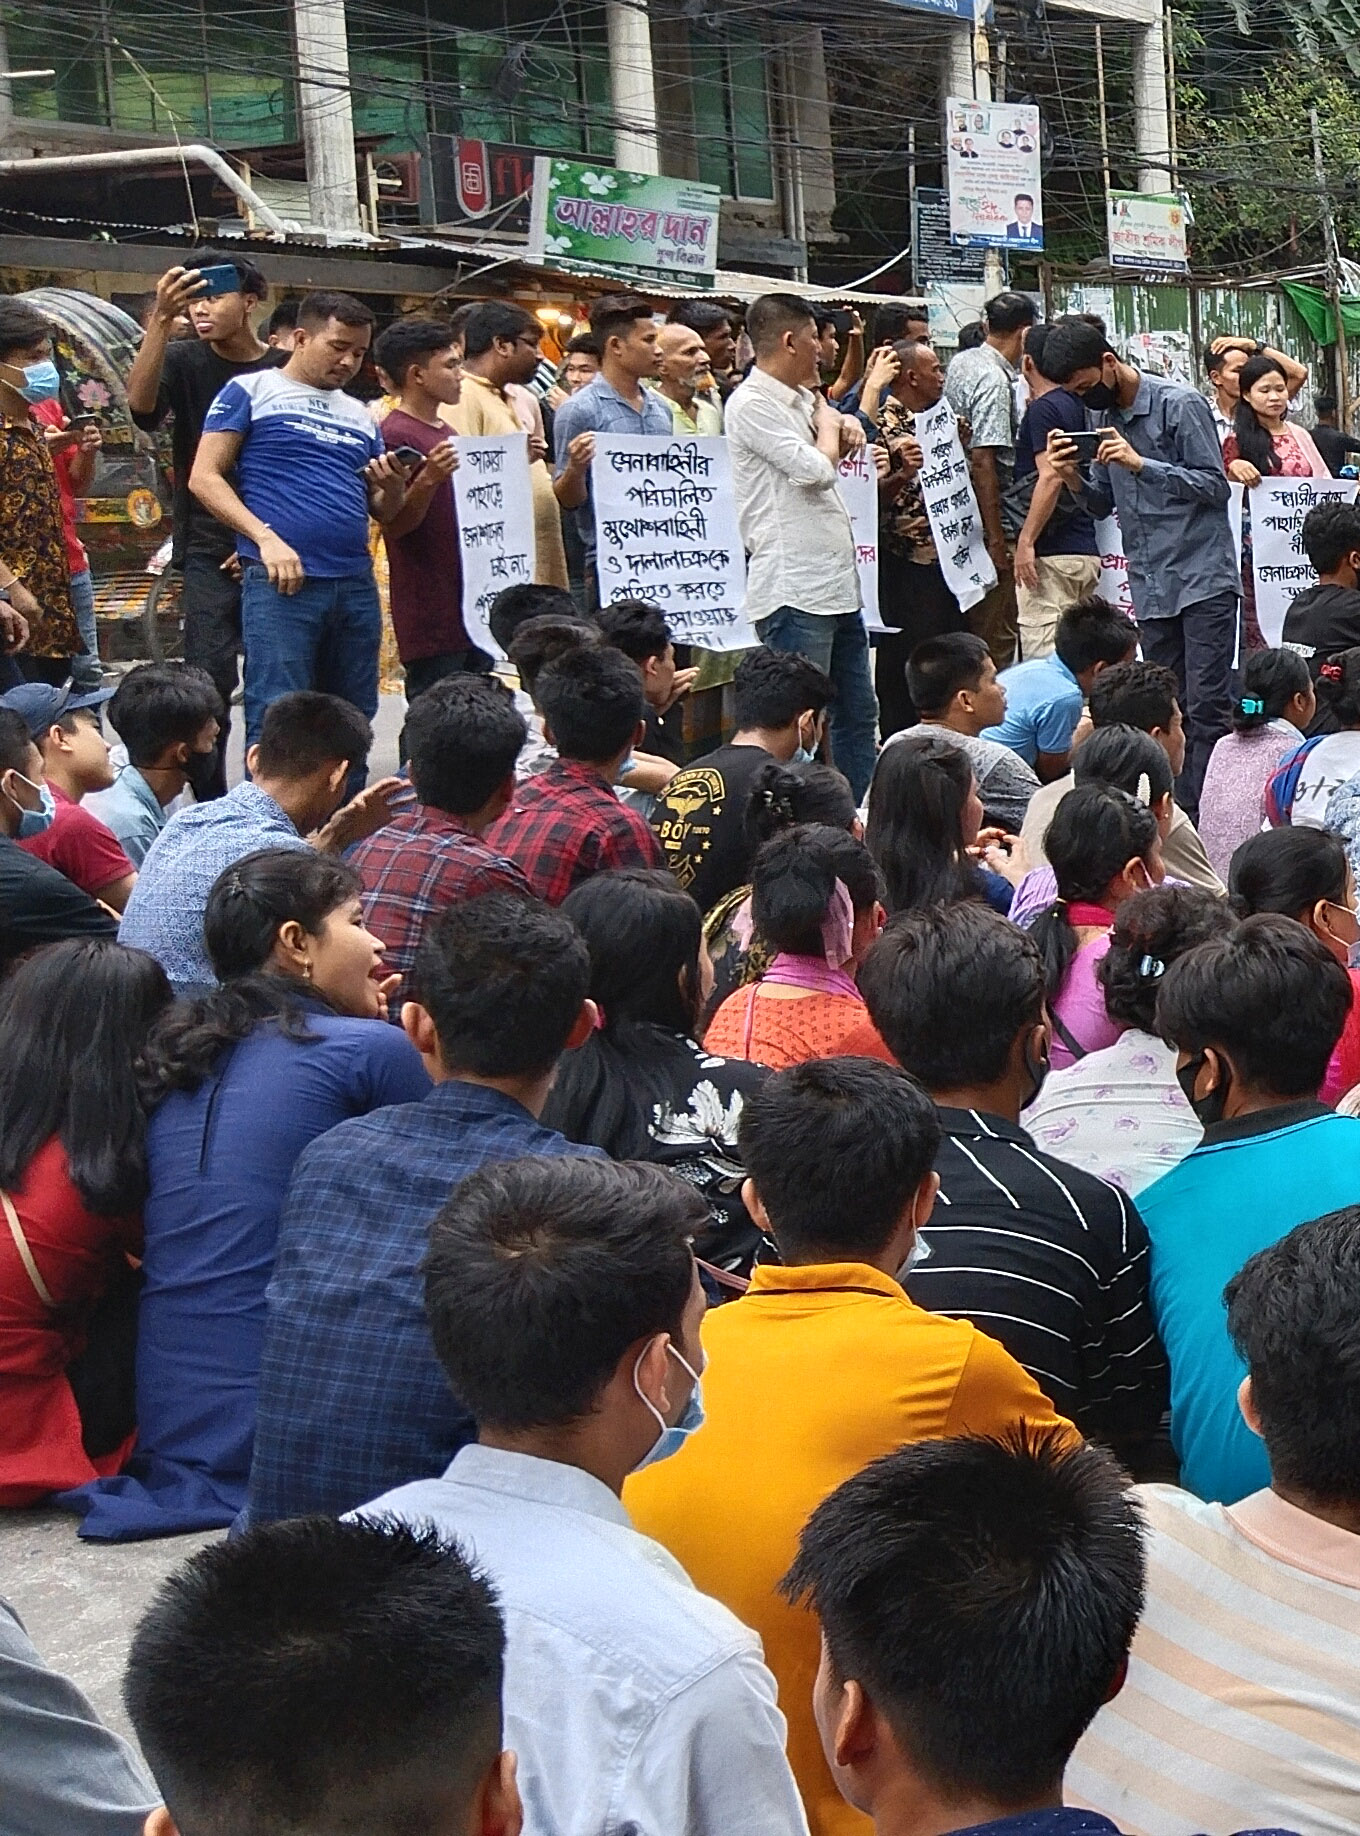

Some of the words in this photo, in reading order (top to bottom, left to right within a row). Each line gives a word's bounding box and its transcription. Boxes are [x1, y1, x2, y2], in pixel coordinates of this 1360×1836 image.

[555, 197, 662, 243] আল্লাহর
[663, 212, 713, 250] দান
[606, 442, 713, 477] সেনাবাহিনীর
[625, 479, 717, 508] পরিচালিত
[605, 555, 622, 574] ও
[675, 581, 727, 602] করতে
[660, 821, 692, 840] BOY
